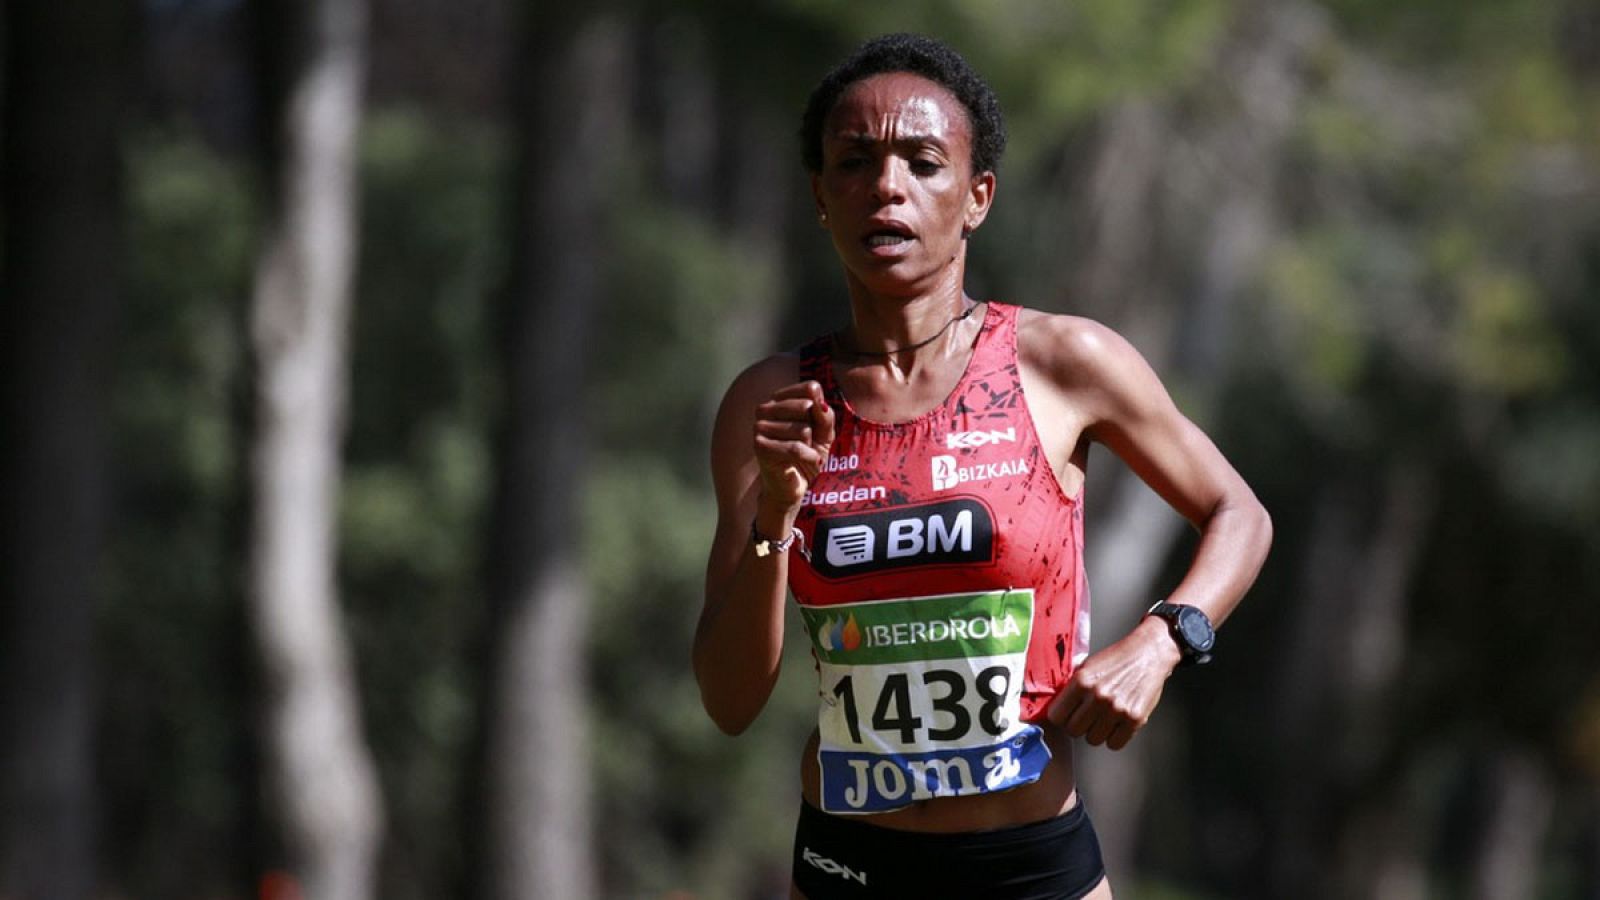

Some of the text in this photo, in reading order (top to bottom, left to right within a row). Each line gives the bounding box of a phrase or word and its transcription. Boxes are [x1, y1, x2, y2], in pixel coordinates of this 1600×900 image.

[946, 427, 1016, 450] KON
[820, 454, 859, 473] lbao
[959, 457, 1028, 482] BIZKAIA
[887, 509, 973, 559] BM
[866, 613, 1021, 649] IBERDROLA
[833, 666, 1012, 744] 1438
[803, 846, 867, 886] KON
